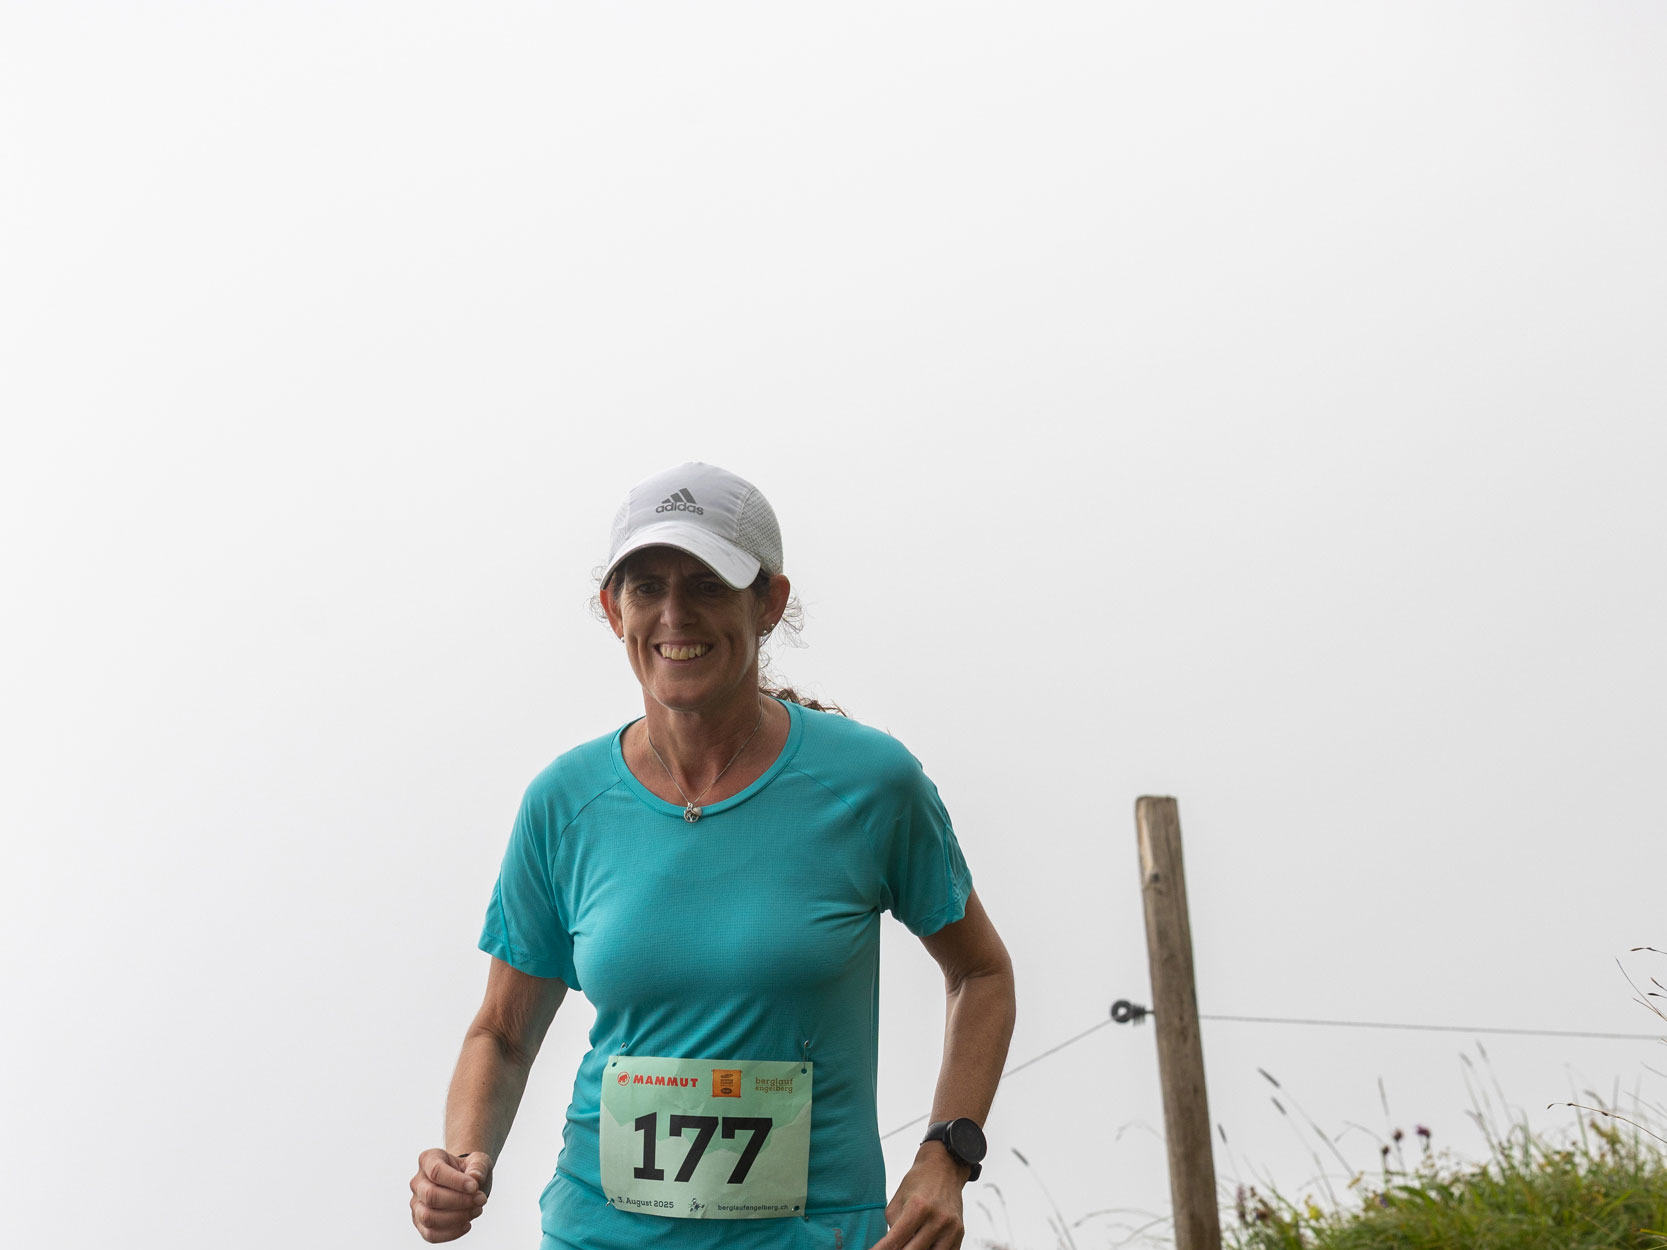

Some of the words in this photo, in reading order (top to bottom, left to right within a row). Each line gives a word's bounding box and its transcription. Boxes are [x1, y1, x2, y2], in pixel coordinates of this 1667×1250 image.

[655, 501, 704, 516] adidas
[633, 1074, 699, 1088] MAMMUT
[755, 1077, 794, 1087] berglauf
[755, 1084, 793, 1093] engelberg
[633, 1112, 773, 1184] 177
[617, 1196, 625, 1204] 3.
[626, 1197, 653, 1208] August
[653, 1200, 675, 1209] 2025
[717, 1204, 789, 1212] berglaufengelberg.ch
